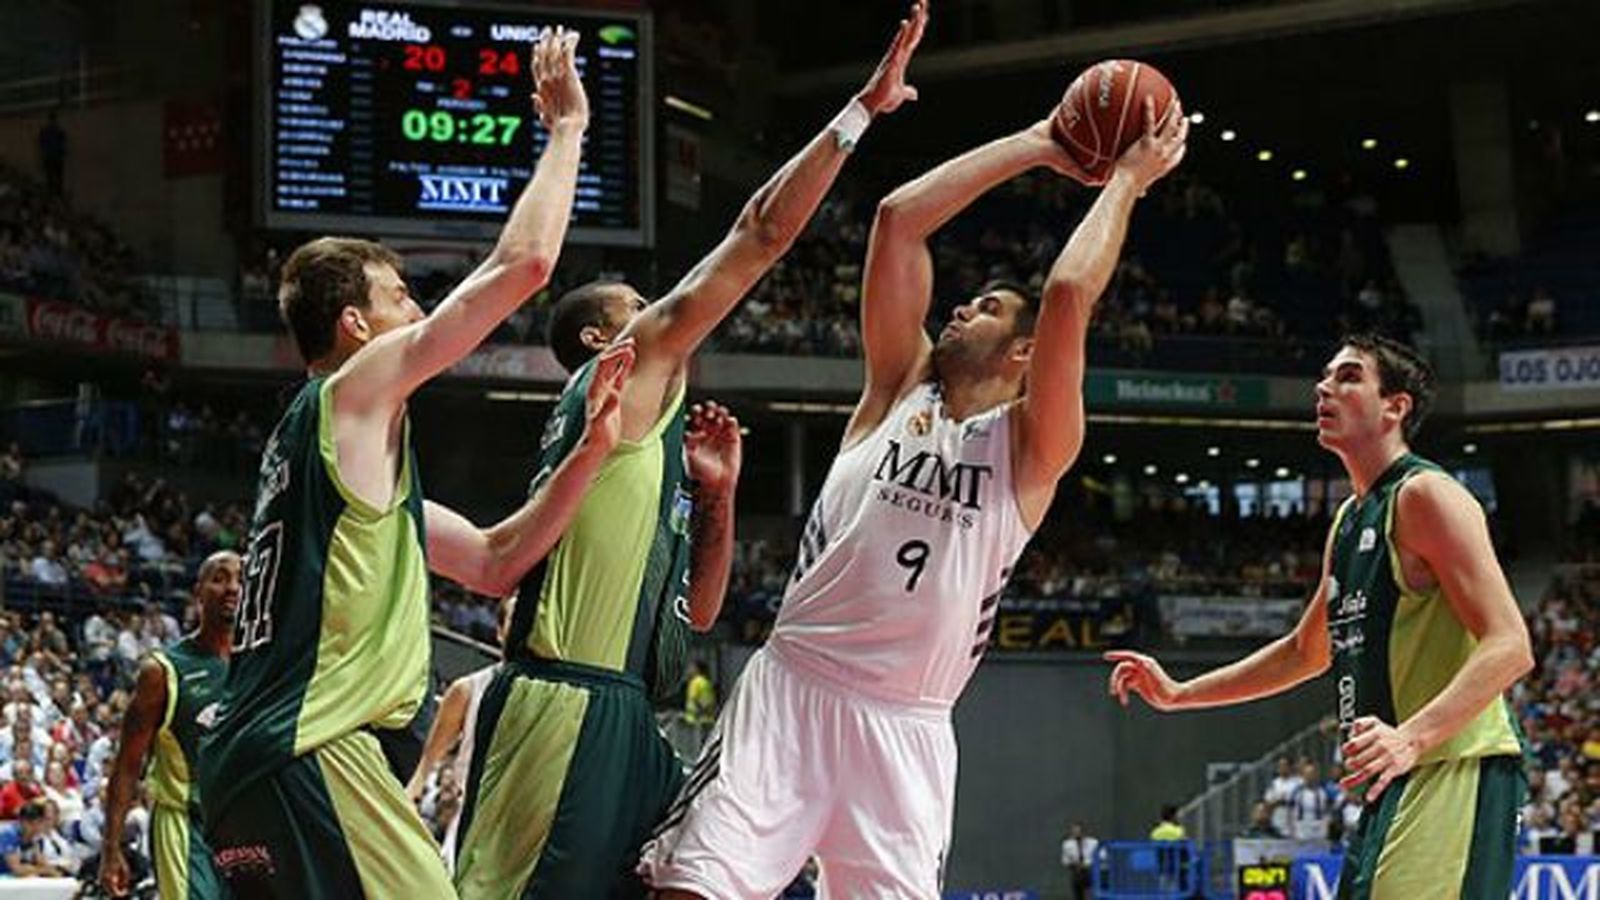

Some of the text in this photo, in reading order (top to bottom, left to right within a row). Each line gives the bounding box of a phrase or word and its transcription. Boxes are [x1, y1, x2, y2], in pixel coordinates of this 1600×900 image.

[360, 9, 413, 27] REAL
[349, 22, 432, 43] MADRID
[490, 24, 541, 41] UNIC
[403, 45, 446, 72] 20
[479, 48, 520, 75] 24
[402, 109, 521, 146] 09:27
[420, 176, 508, 203] MMT
[1502, 358, 1548, 385] LOS
[874, 439, 993, 511] MMT
[896, 539, 930, 592] 9
[999, 614, 1098, 650] EAL
